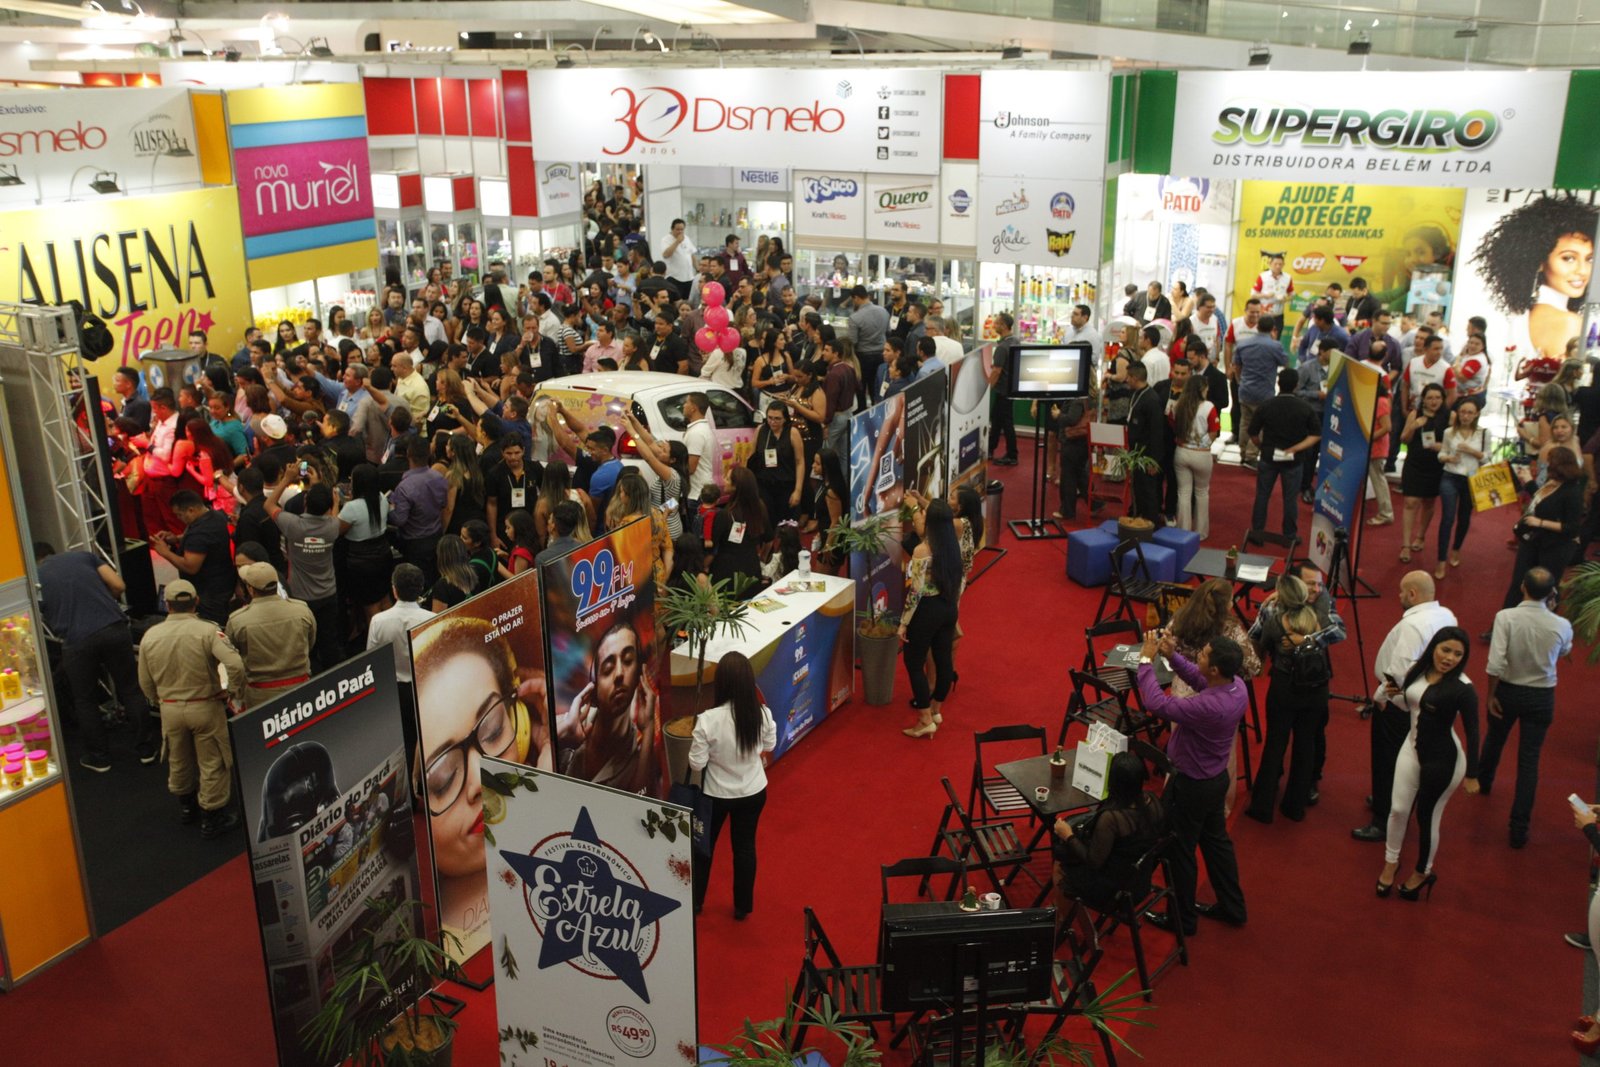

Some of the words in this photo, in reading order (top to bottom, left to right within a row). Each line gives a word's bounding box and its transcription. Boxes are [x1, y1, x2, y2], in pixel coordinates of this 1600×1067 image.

[0, 104, 48, 115] Exclusivo:
[693, 97, 845, 134] Dismelo
[1018, 131, 1047, 141] Family
[1050, 131, 1092, 142] Company
[1211, 106, 1501, 149] SUPERGIRO
[640, 146, 677, 155] anos
[254, 164, 289, 180] nova
[1213, 154, 1355, 170] DISTRIBUIDORA
[1366, 157, 1431, 172] BELÉM
[1441, 160, 1493, 174] LTDA
[255, 163, 360, 215] muriel
[879, 191, 929, 210] Quero
[1279, 186, 1339, 204] AJUDE
[1341, 186, 1355, 204] A
[1164, 191, 1201, 213] PATO
[1260, 205, 1373, 226] PROTEGER
[993, 229, 1030, 255] glade
[1048, 233, 1072, 250] Raid
[1244, 228, 1257, 238] OS
[1259, 228, 1296, 239] SONHOS
[1298, 228, 1334, 239] DESSAS
[1335, 228, 1384, 241] CRIANÇAS
[18, 219, 216, 320] ALISENA
[1292, 256, 1326, 273] OFF!
[571, 549, 614, 618] 99
[492, 618, 498, 626] O
[498, 605, 523, 623] PRAZER
[484, 627, 501, 643] ESTÁ
[500, 622, 512, 635] NO
[512, 615, 524, 629] AR!
[262, 702, 313, 740] Diário
[315, 689, 336, 711] do
[338, 664, 375, 700] Pará
[300, 806, 342, 847] Diário
[363, 760, 390, 795] Pará
[544, 842, 574, 856] FESTIVAL
[577, 842, 632, 880] GASTRONÔMICO
[530, 864, 643, 920] Estrela
[325, 908, 344, 932] MAIS
[342, 890, 362, 911] CARA
[556, 912, 644, 965] Azul
